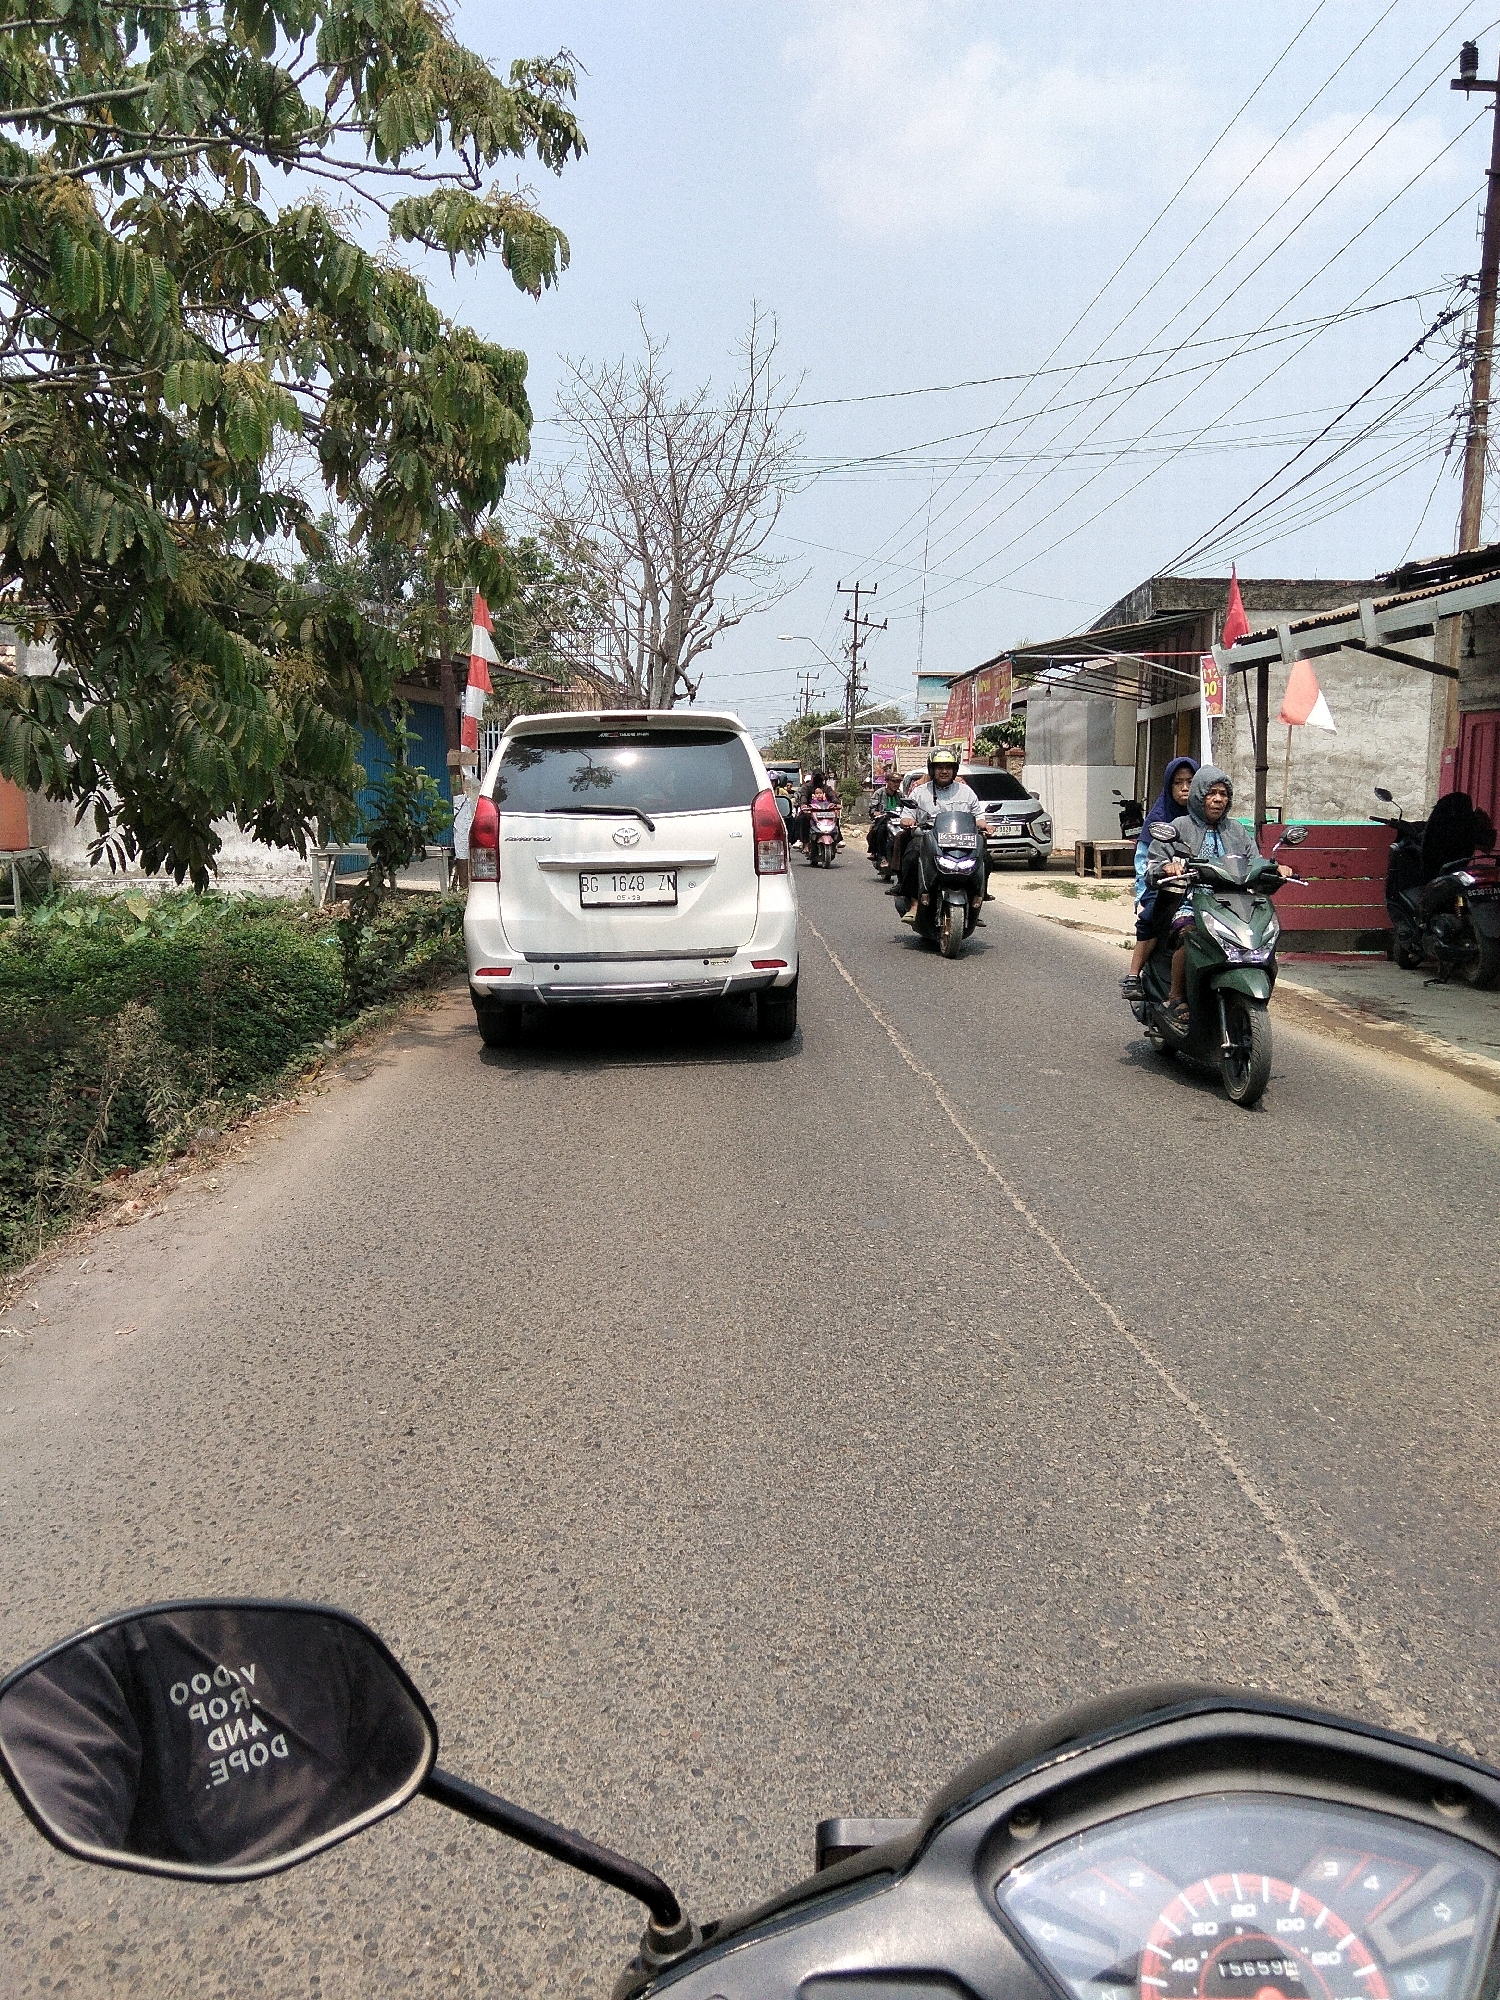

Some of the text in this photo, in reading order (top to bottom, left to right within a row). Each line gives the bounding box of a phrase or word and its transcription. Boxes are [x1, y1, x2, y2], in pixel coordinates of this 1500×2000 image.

[581, 874, 676, 892] BG 1648 ZN
[1323, 1861, 1339, 1877] 3
[1128, 1872, 1145, 1888] 2
[1363, 1875, 1380, 1890] 4
[1171, 1957, 1199, 1973] 40
